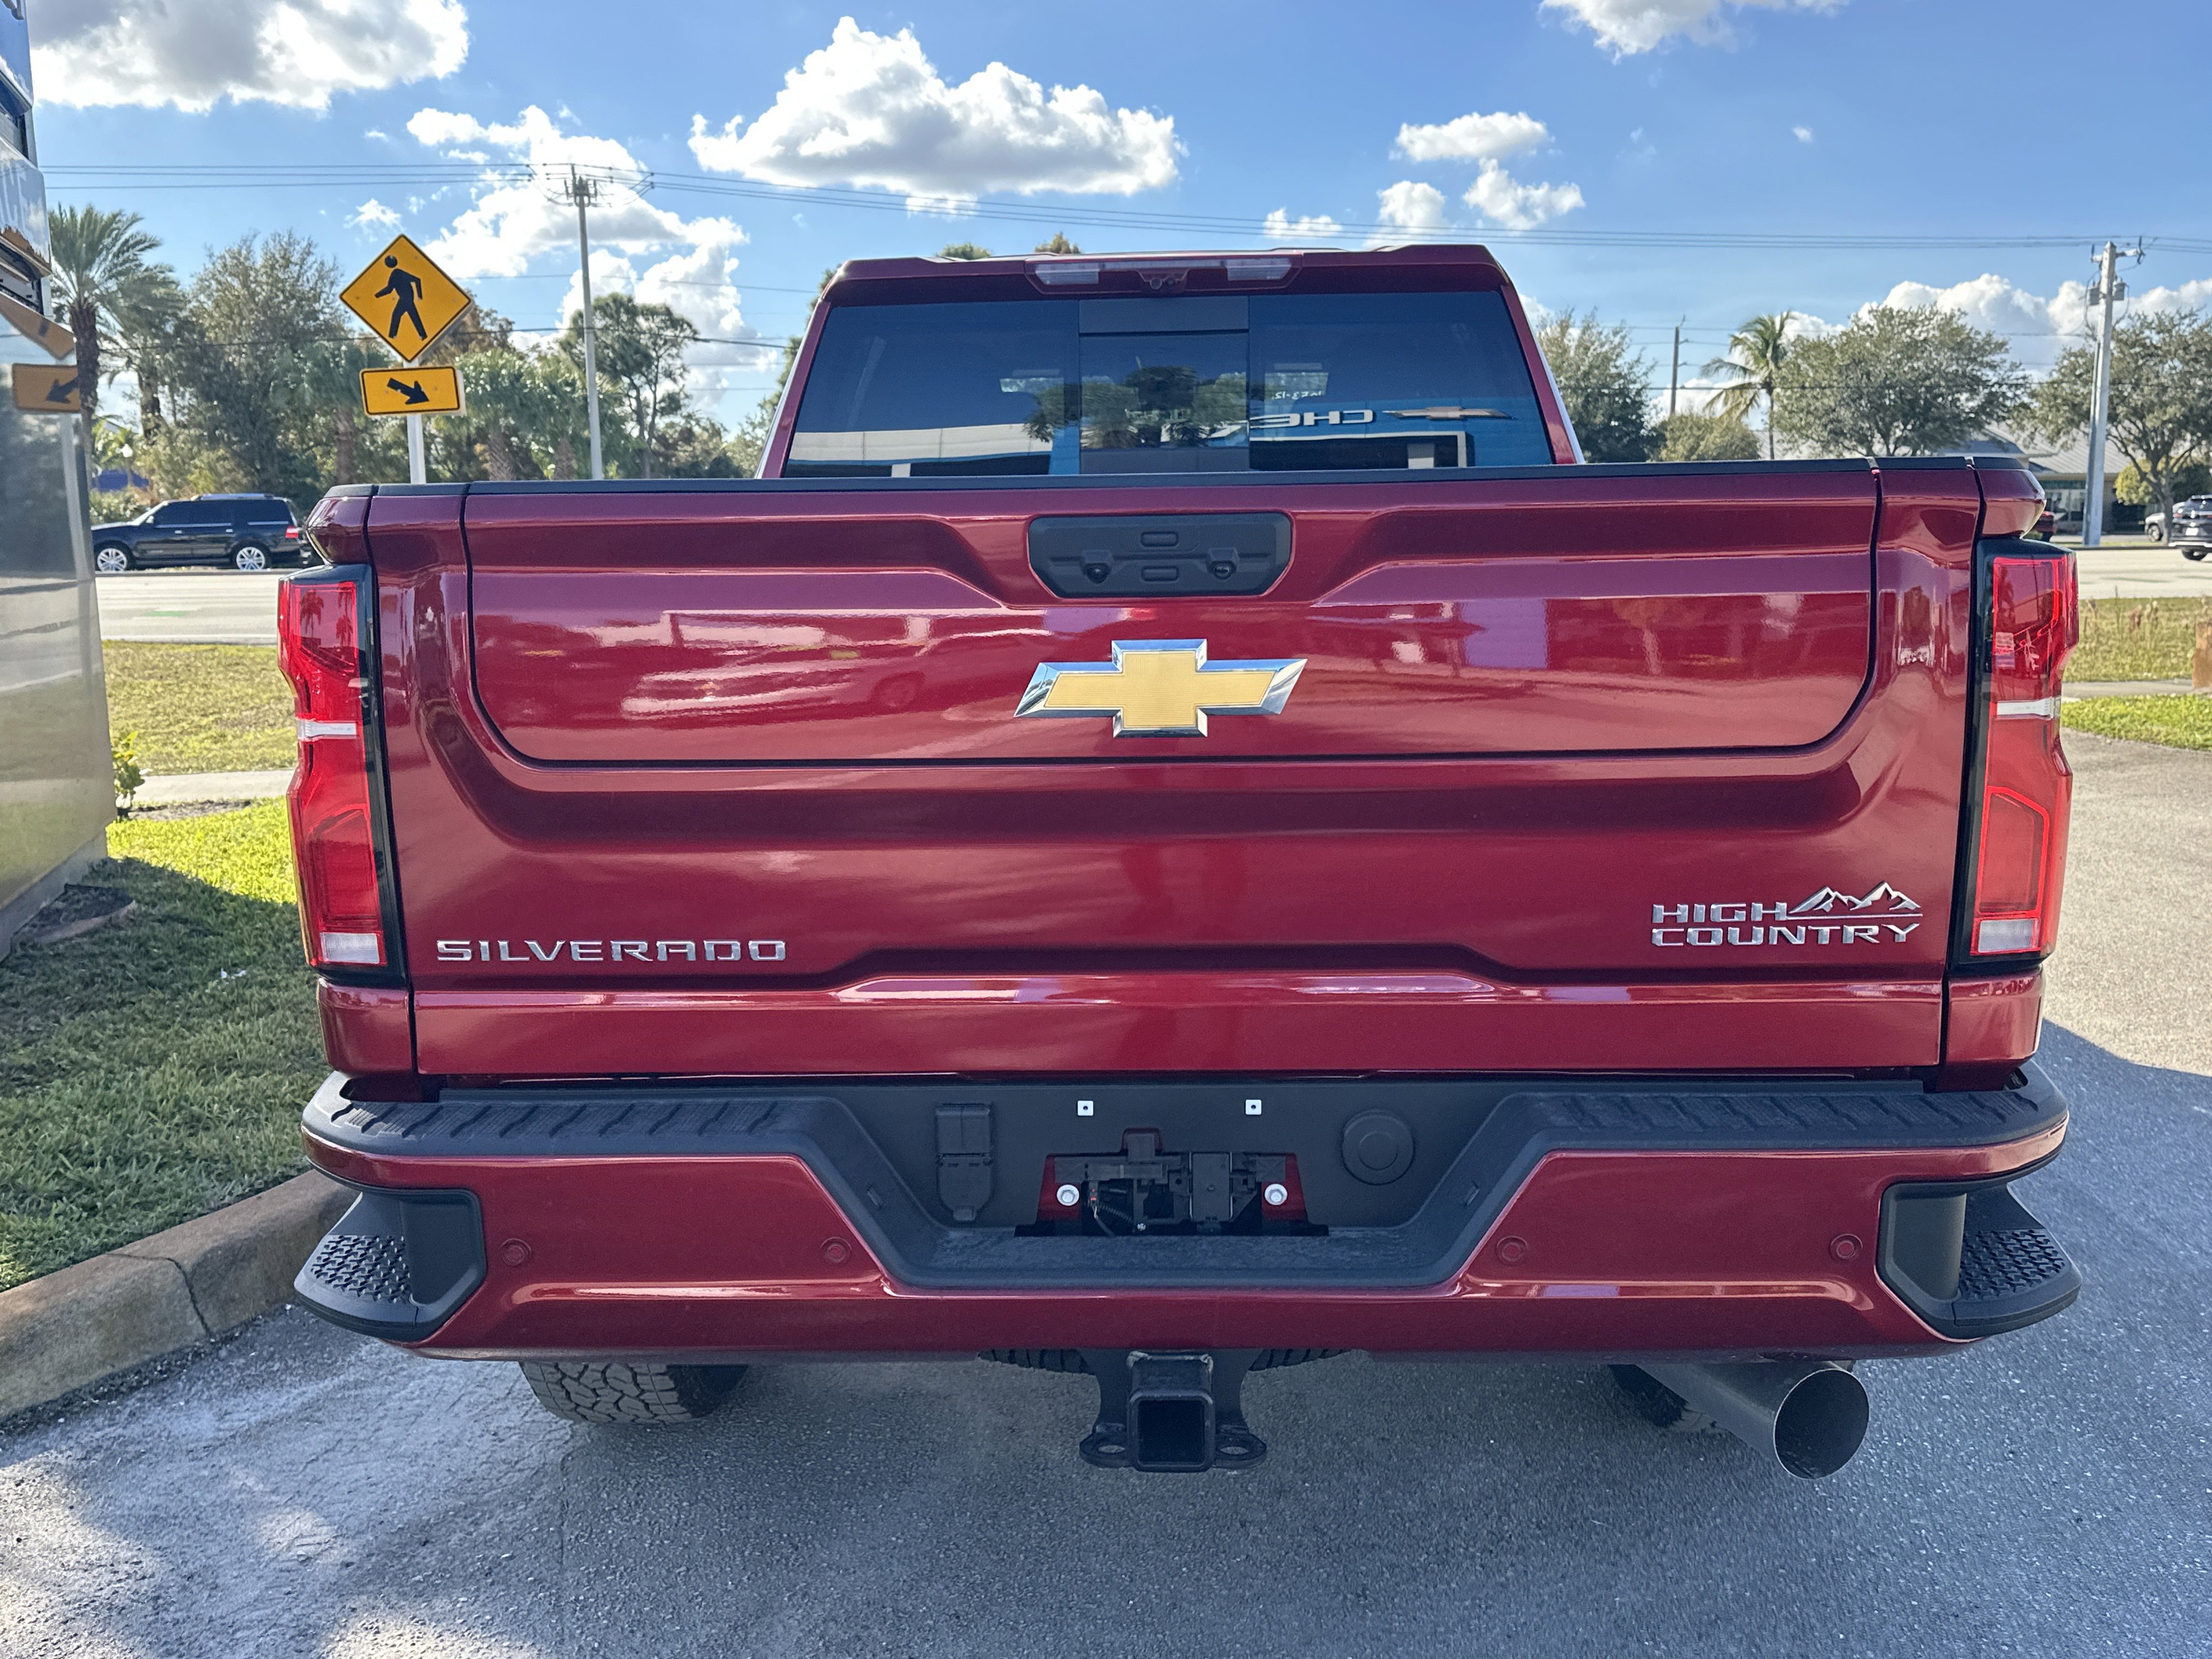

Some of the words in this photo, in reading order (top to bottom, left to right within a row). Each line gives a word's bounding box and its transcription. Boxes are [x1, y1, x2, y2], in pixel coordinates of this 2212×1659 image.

[1652, 902, 1788, 923] HIGH
[1652, 923, 1920, 946] COUNTRY
[437, 940, 786, 962] SILVERADO
